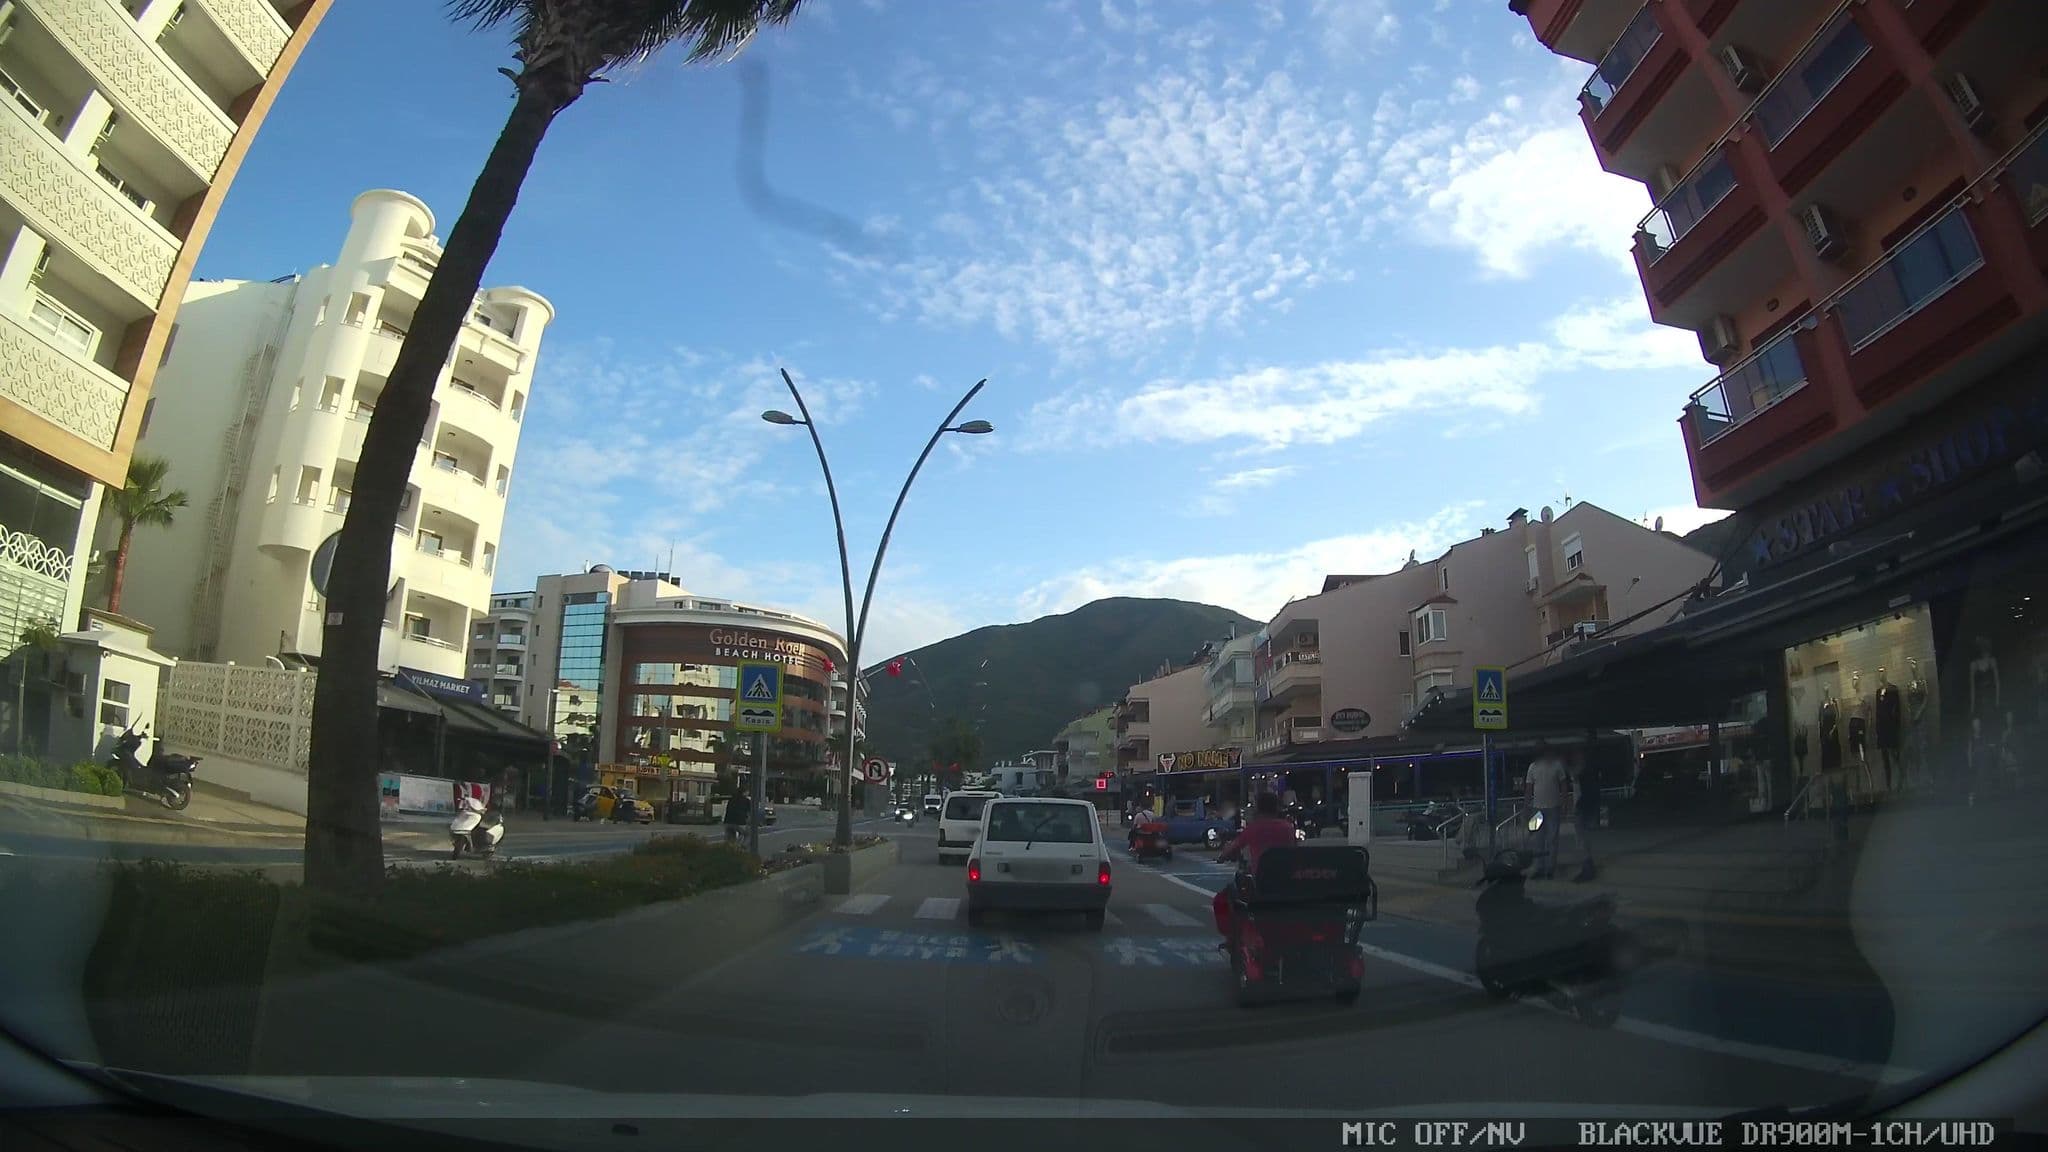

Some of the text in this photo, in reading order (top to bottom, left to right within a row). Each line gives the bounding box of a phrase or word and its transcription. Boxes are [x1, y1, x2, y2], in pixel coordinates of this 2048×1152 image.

[709, 628, 767, 649] Golden
[715, 647, 758, 659] BEACH
[439, 681, 471, 694] MARKET
[1177, 750, 1229, 769] NO NAME
